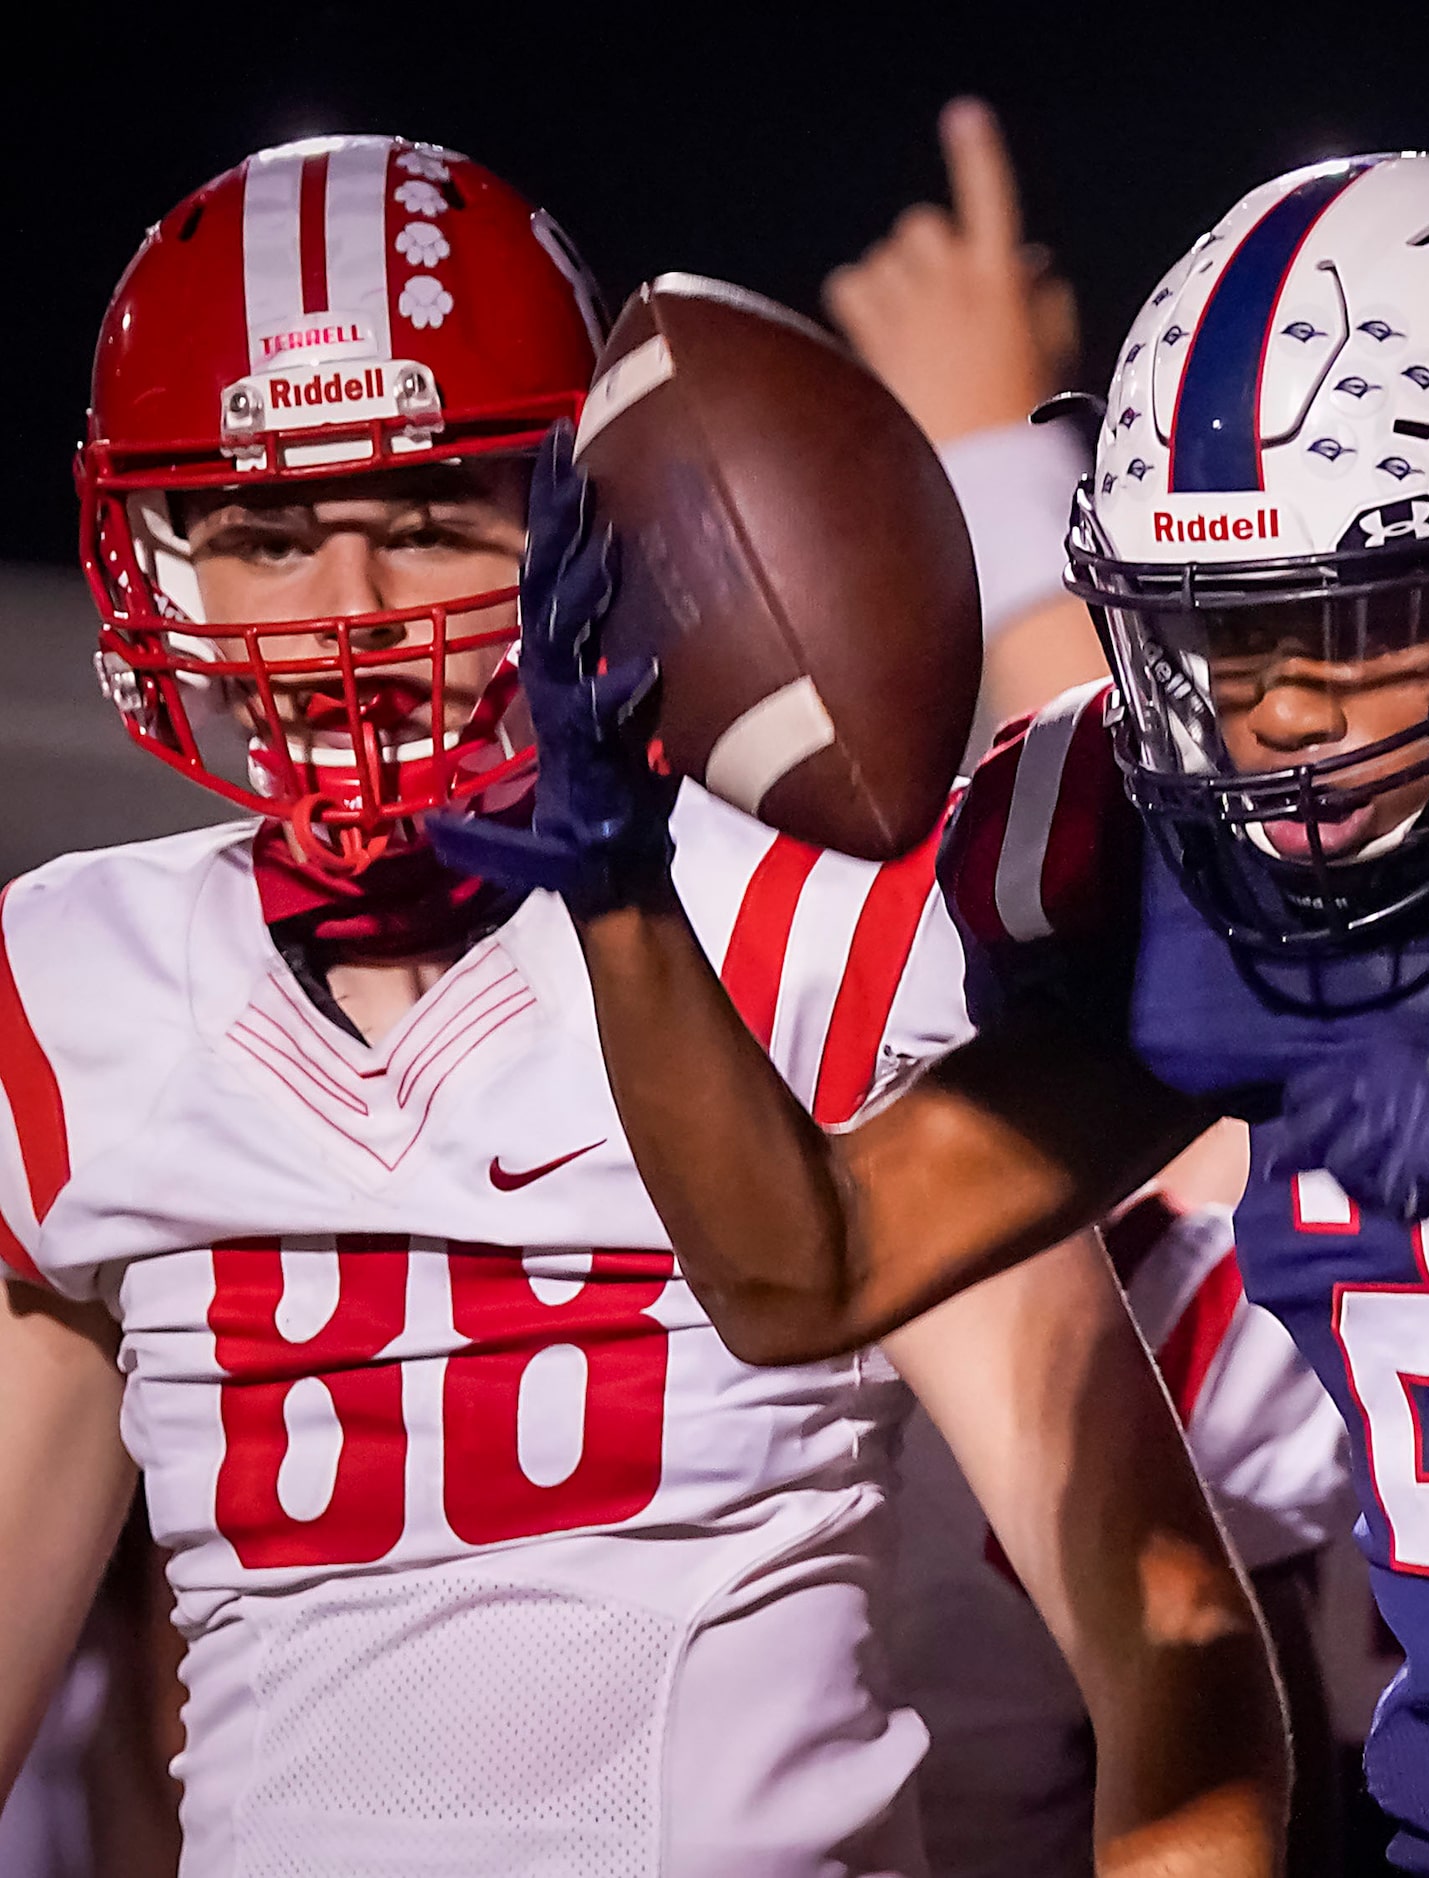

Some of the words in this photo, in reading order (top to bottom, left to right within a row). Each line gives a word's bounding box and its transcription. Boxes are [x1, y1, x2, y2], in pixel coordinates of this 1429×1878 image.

[259, 324, 365, 355] TERRELL
[269, 368, 384, 409] Riddell
[1153, 508, 1279, 542] Riddell
[208, 1234, 674, 1570] 88
